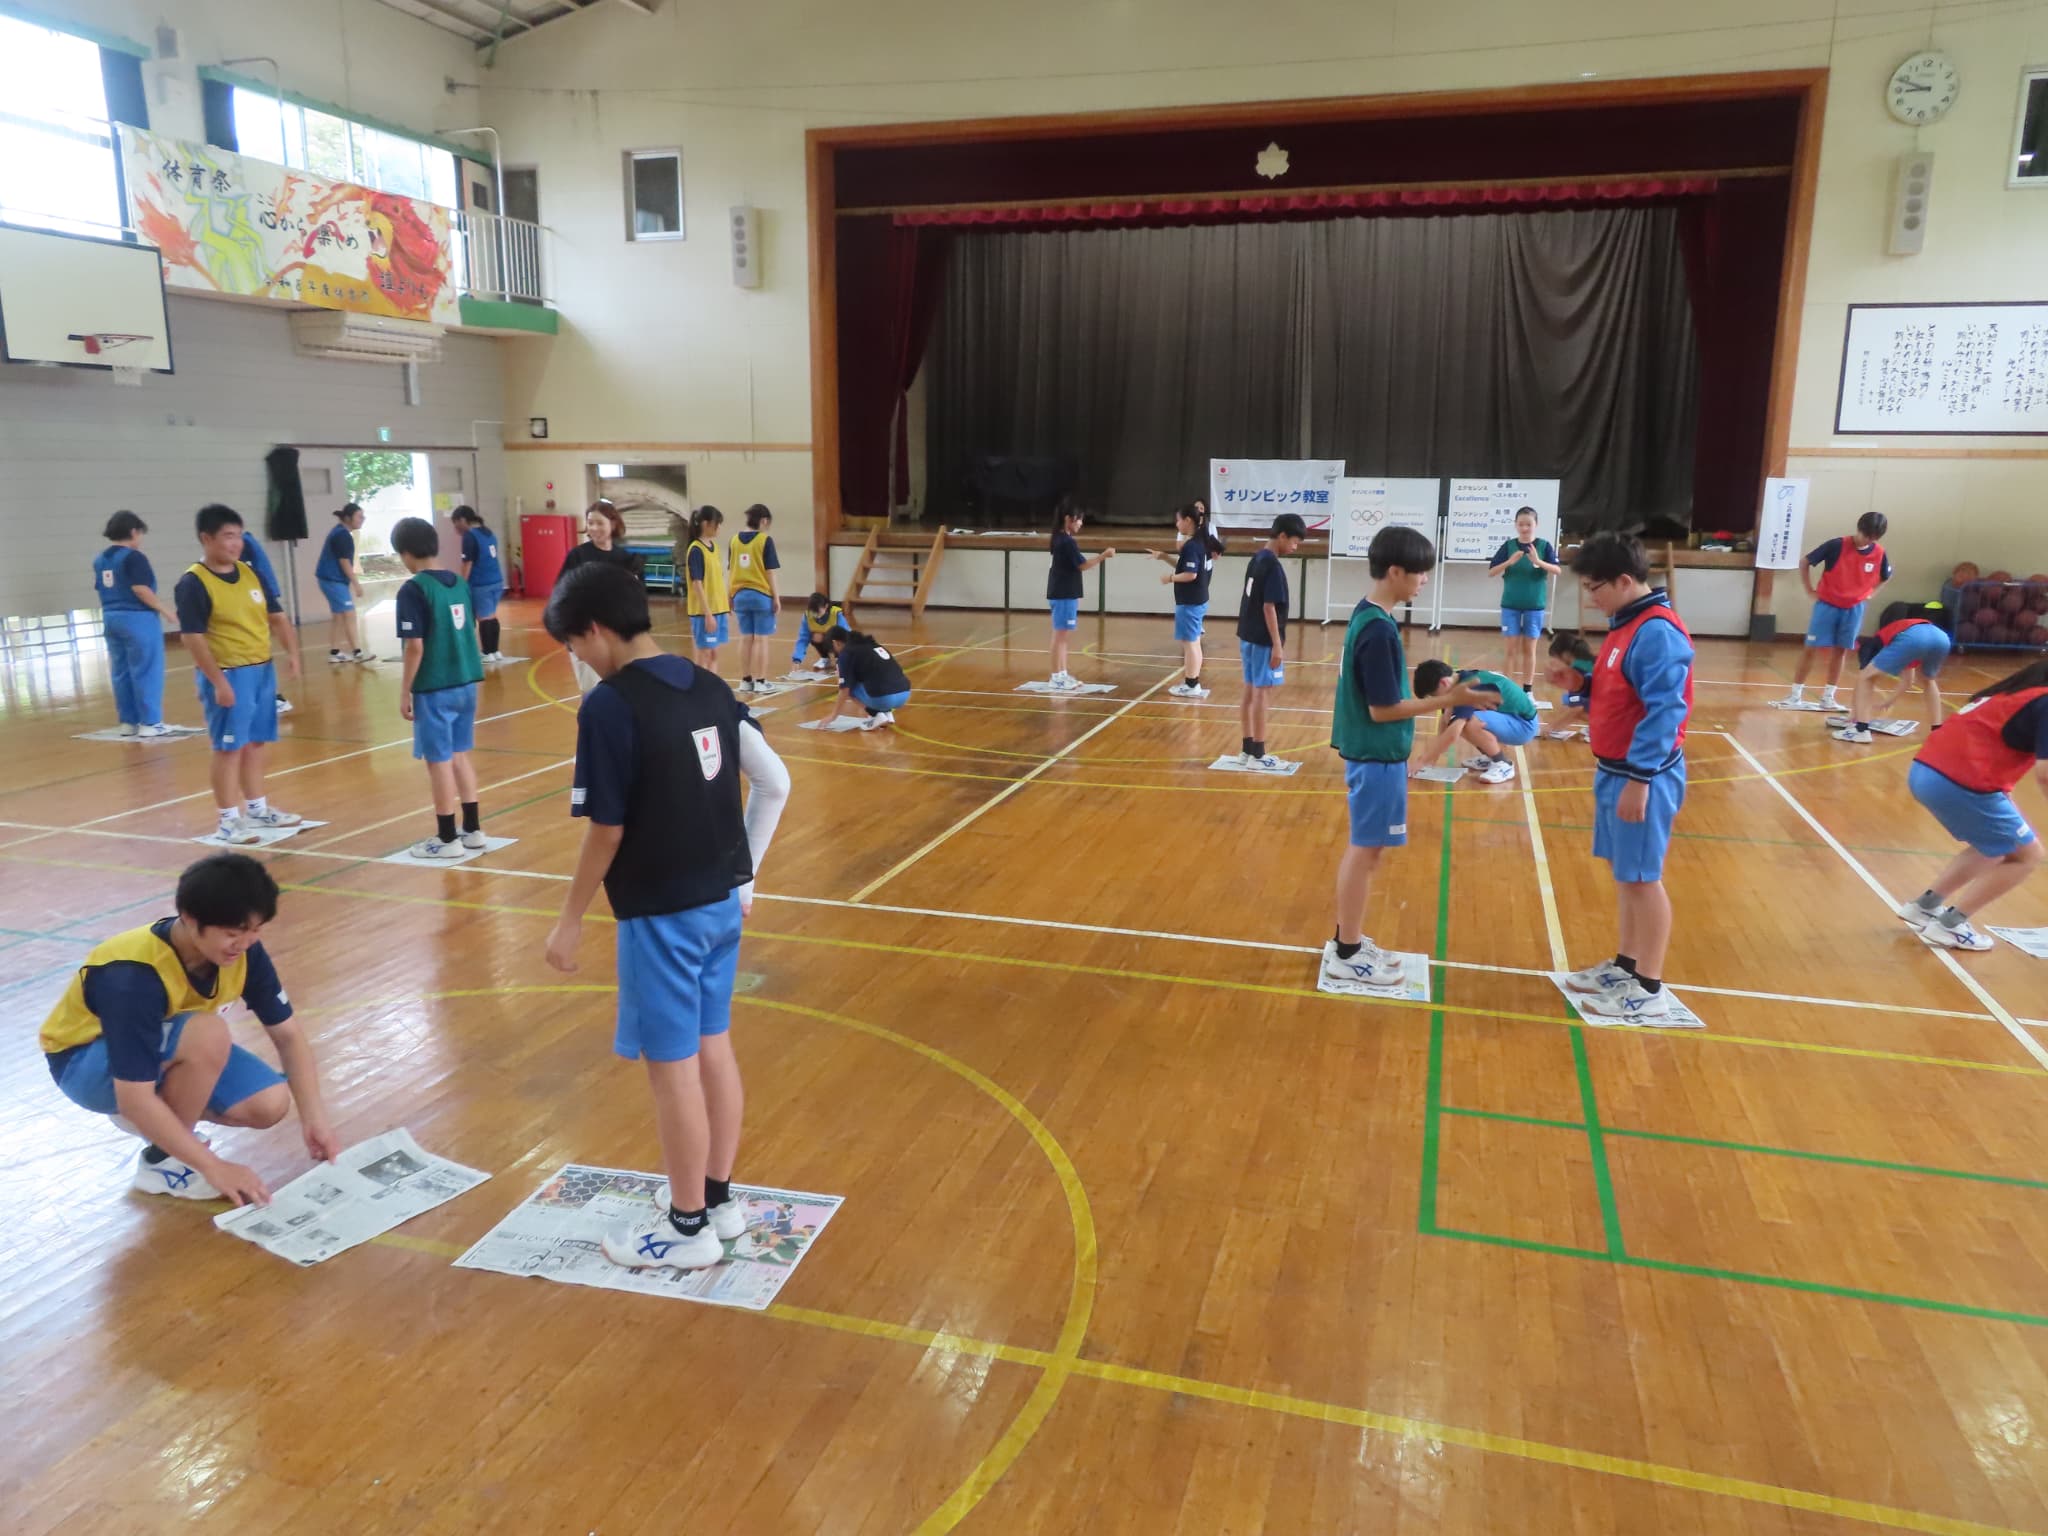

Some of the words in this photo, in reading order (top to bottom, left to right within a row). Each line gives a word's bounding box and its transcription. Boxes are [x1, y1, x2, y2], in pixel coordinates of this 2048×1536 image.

[162, 159, 232, 193] 体育祭
[1223, 488, 1330, 504] オリンピック教室
[1452, 521, 1488, 529] Friendship
